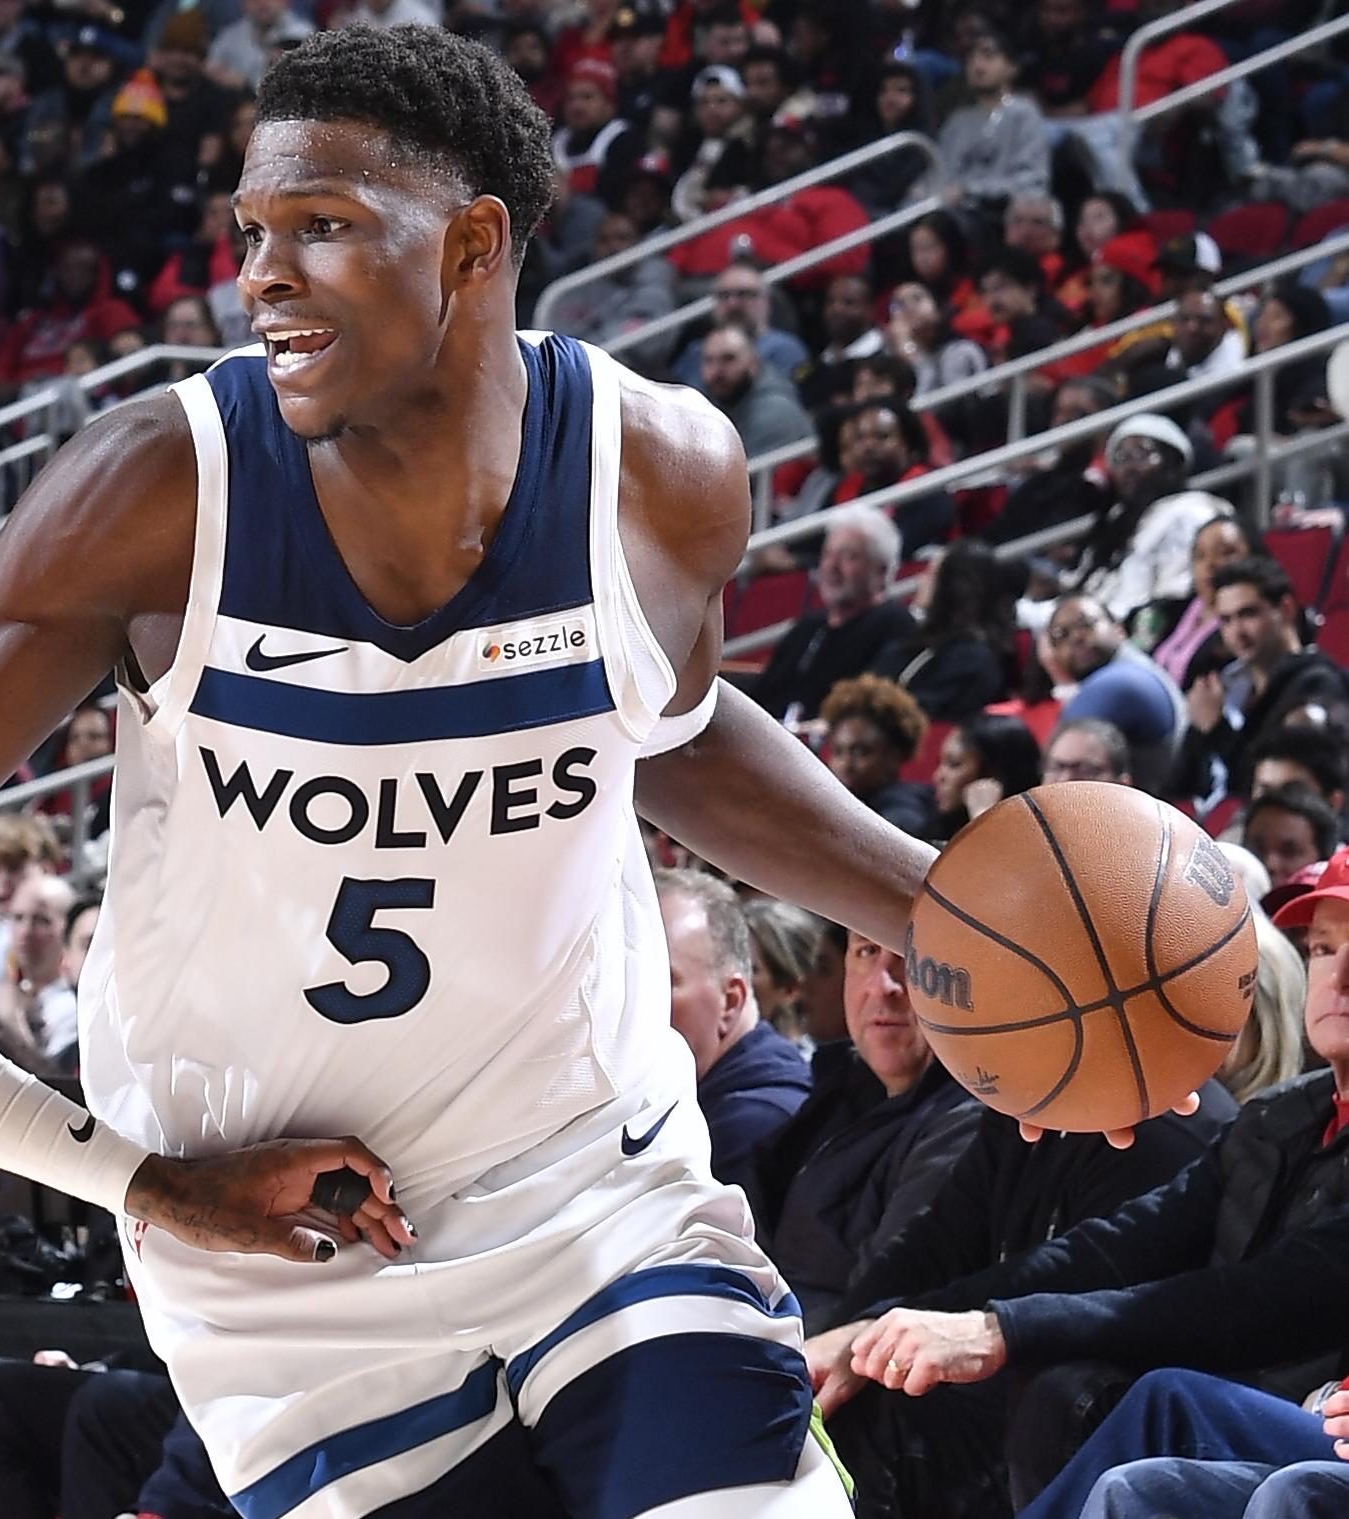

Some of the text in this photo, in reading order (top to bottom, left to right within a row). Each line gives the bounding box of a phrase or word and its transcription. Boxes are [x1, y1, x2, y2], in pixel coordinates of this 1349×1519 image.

[503, 626, 586, 660] sezzle
[198, 745, 598, 849] WOLVES
[302, 876, 436, 1025] 5
